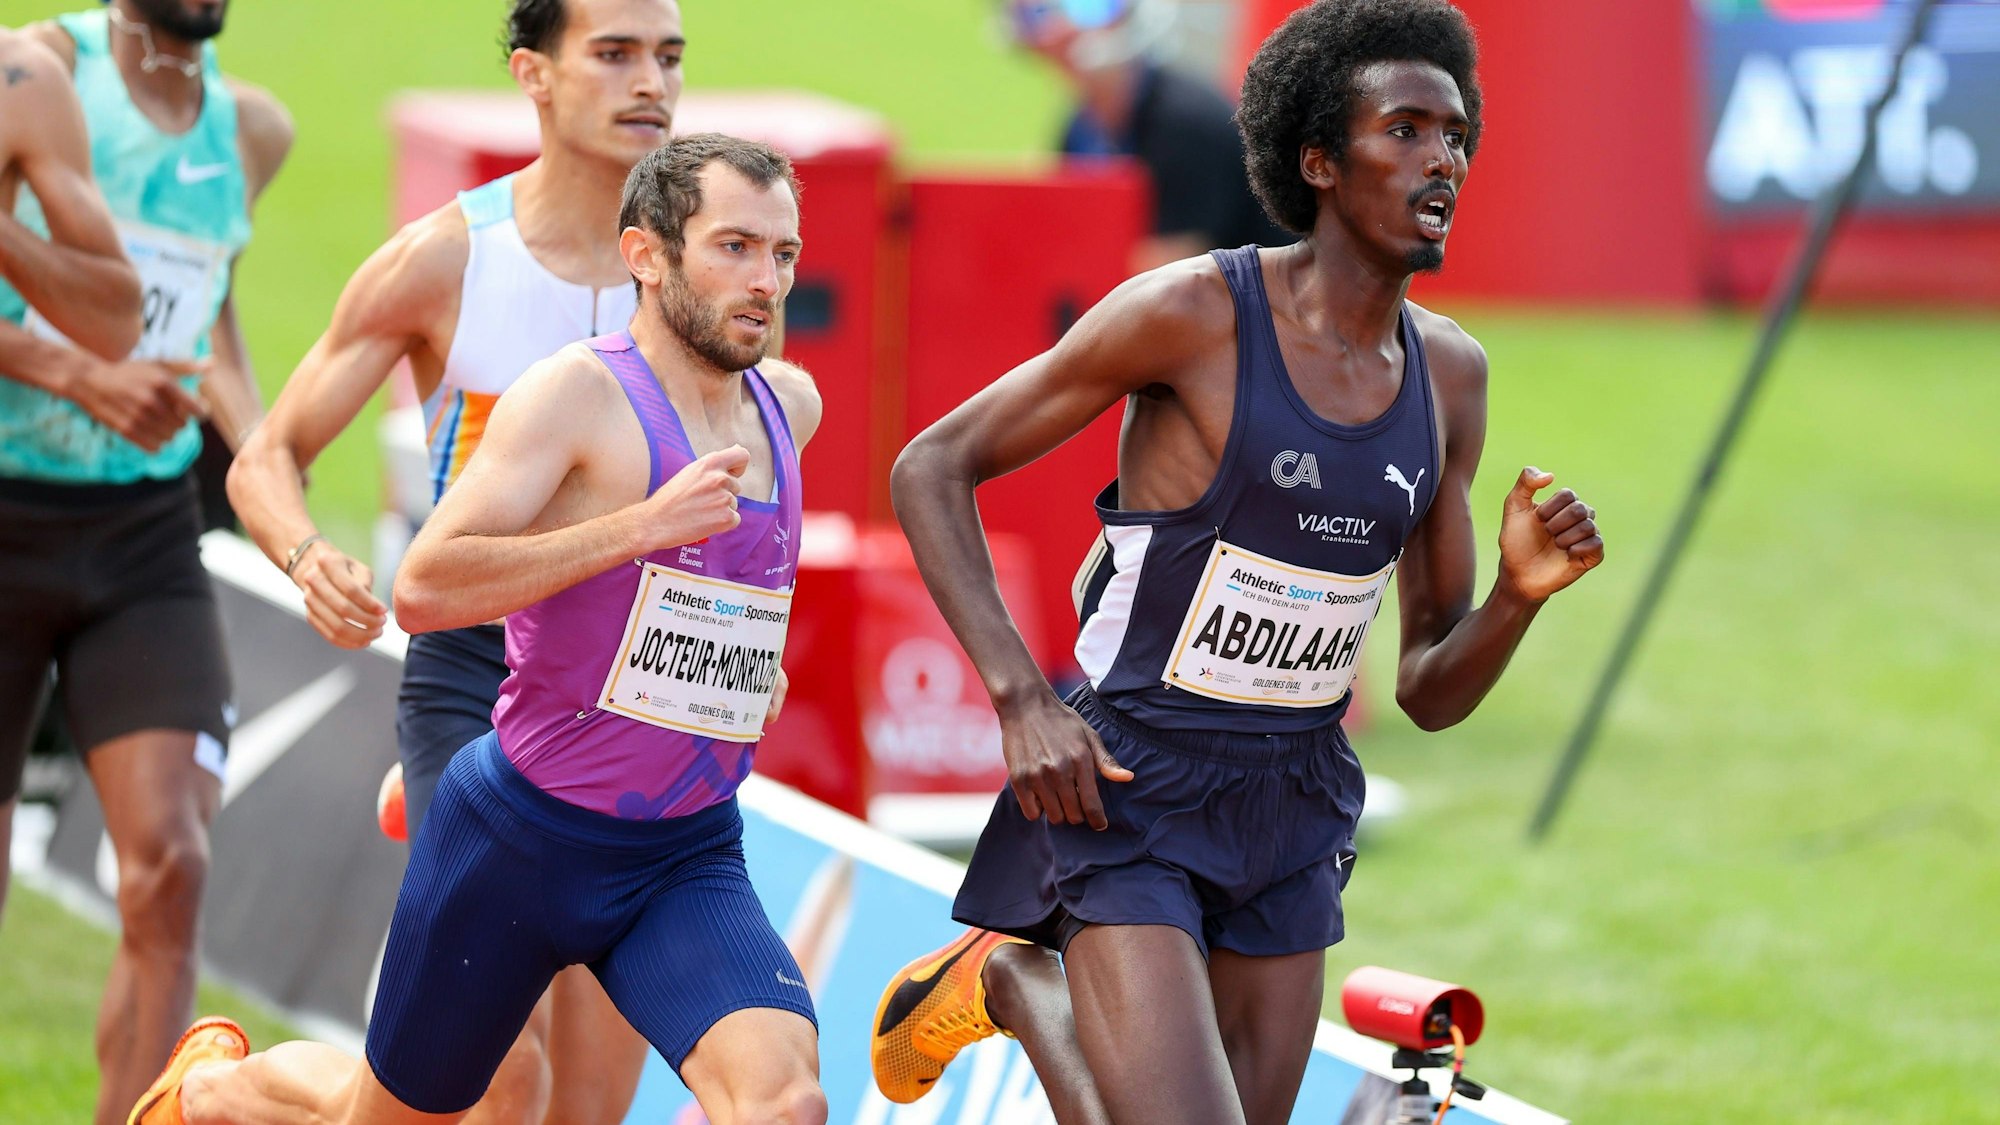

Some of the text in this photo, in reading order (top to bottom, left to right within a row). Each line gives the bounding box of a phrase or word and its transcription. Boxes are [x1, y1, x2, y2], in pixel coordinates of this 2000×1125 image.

[1270, 449, 1322, 490] CA
[1297, 513, 1376, 537] VIACTIV
[1321, 534, 1370, 545] Krankenkasse
[1230, 568, 1378, 606] Athletic Sport Sponsoring
[662, 588, 788, 624] Athletic Sport Sponsori
[1242, 590, 1310, 611] ICH BIN DEIN AUTO
[674, 610, 734, 628] ICH BIN DEIN AUTO
[1192, 604, 1367, 671] ABDILAAHI
[1252, 678, 1285, 689] GOLDENES
[1285, 680, 1302, 690] OVAL
[688, 702, 720, 718] GOLDENES
[720, 709, 736, 721] OVAL
